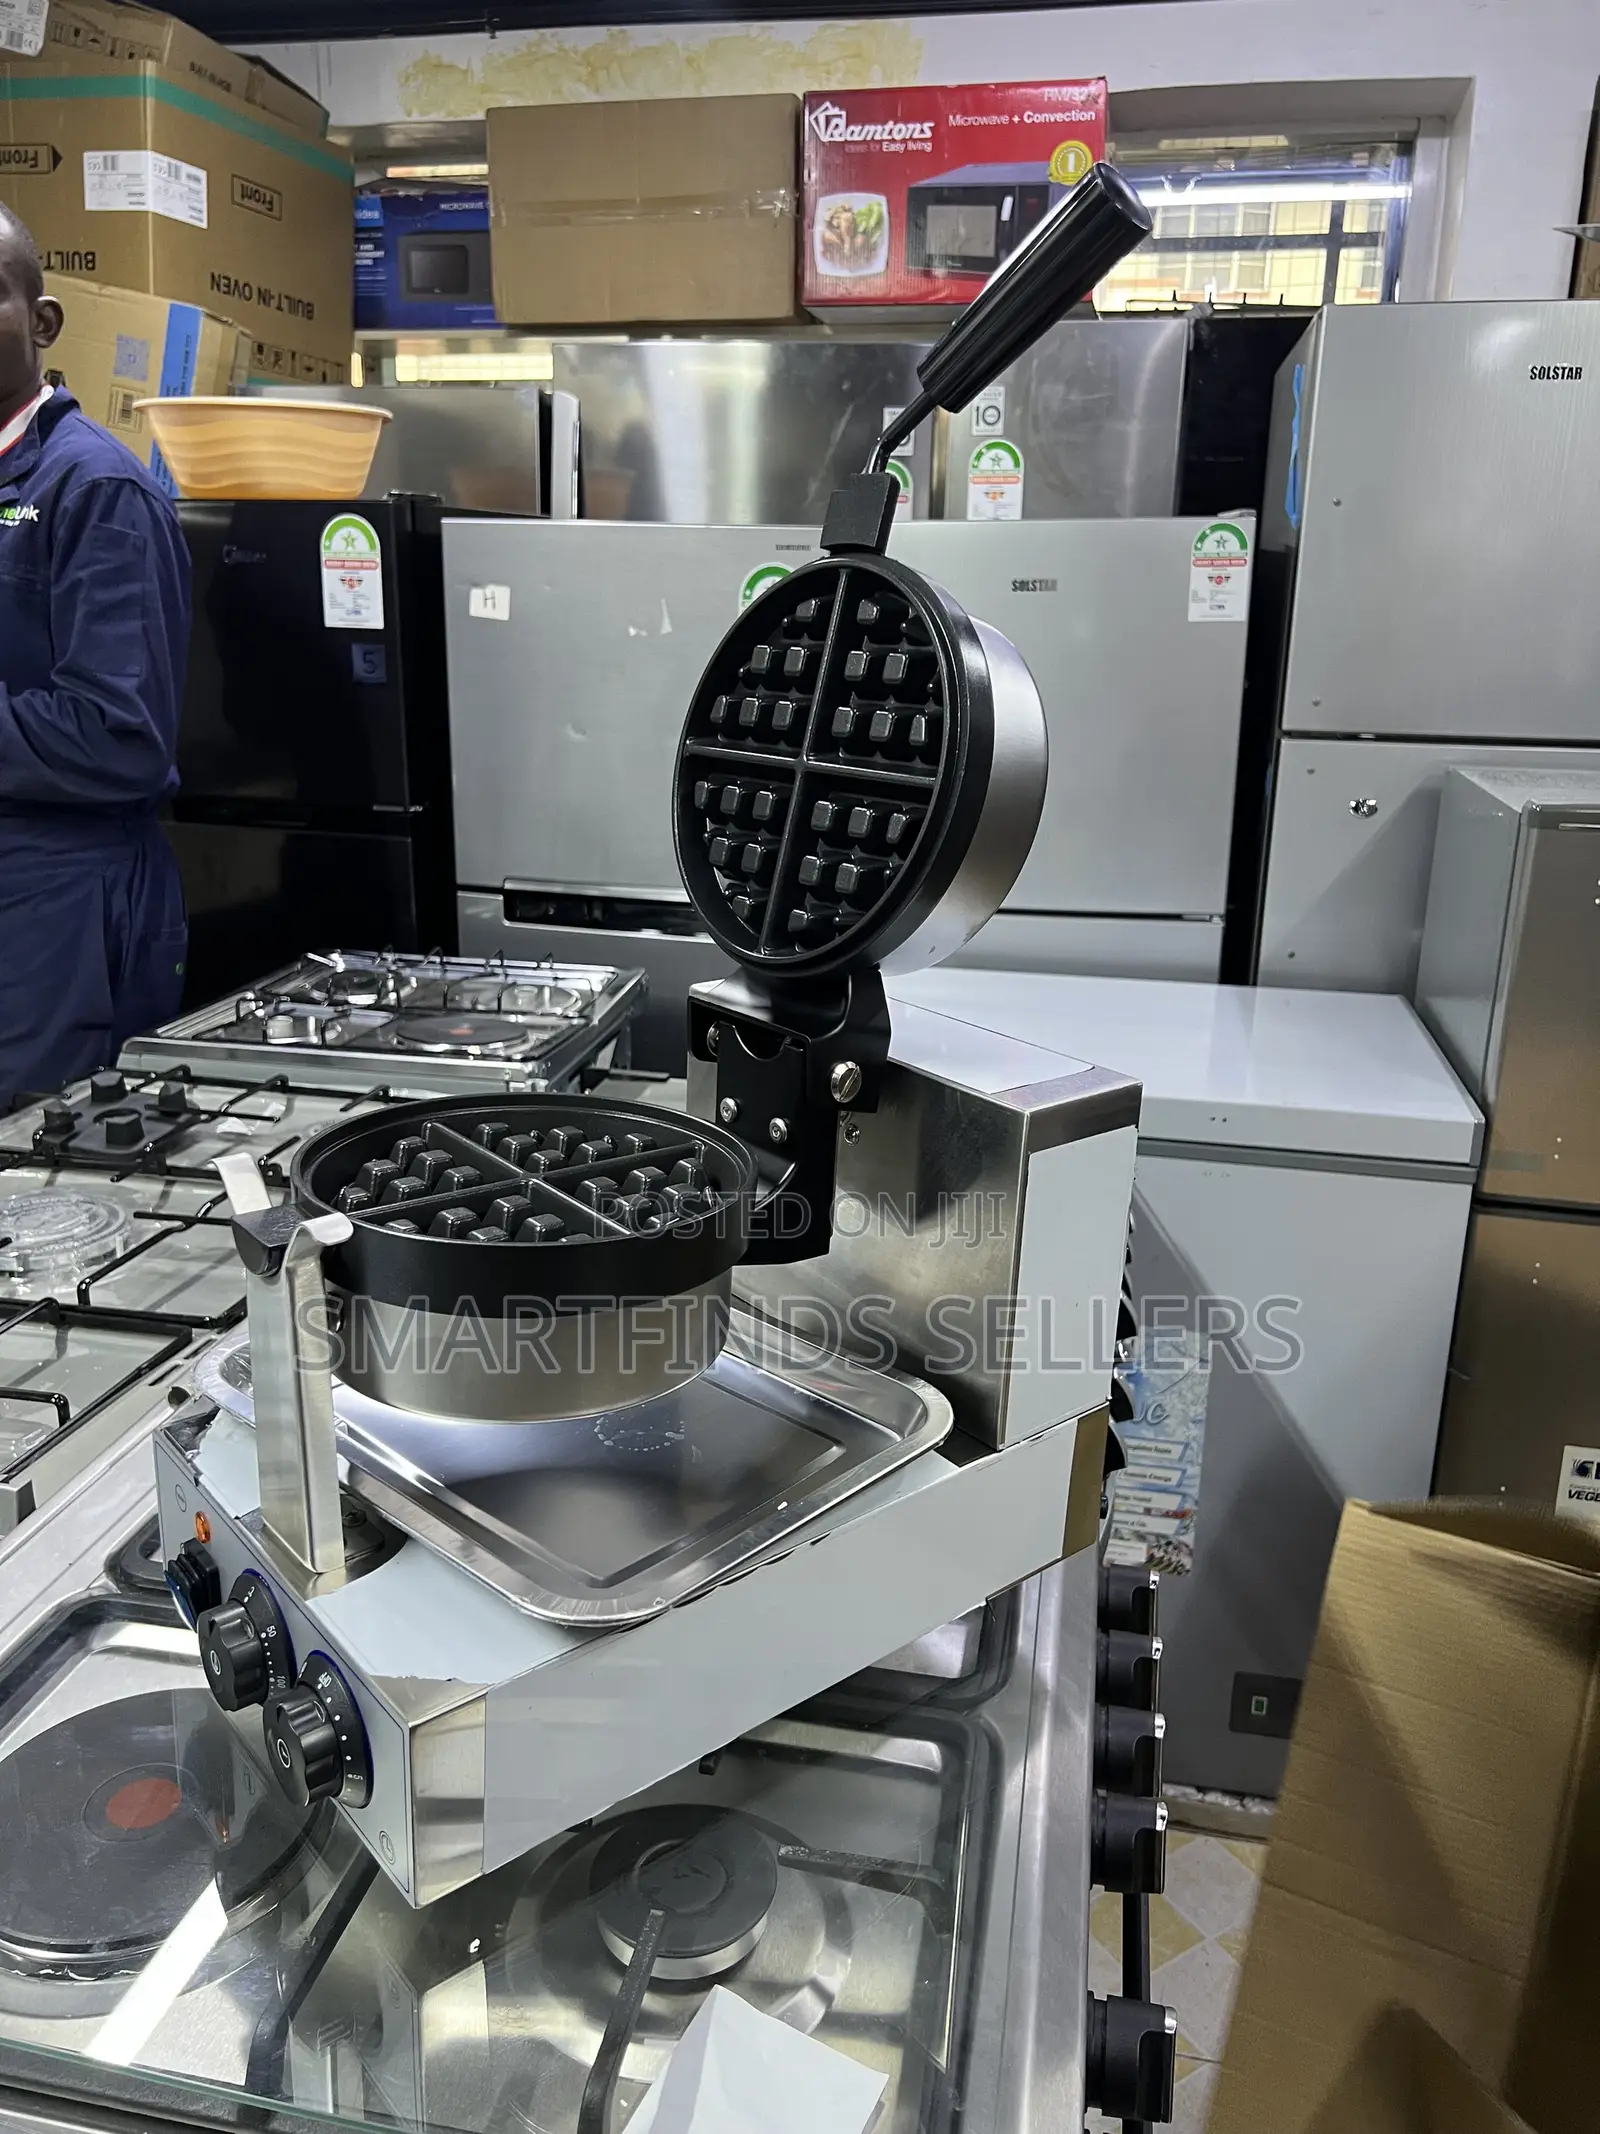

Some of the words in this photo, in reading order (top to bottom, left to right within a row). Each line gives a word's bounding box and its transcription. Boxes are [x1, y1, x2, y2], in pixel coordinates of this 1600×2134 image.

[949, 113, 1010, 127] Microwave
[1023, 109, 1096, 124] Convection
[882, 141, 906, 153] Easy
[907, 140, 933, 153] living
[240, 183, 274, 213] Front
[210, 271, 253, 302] OVEN
[1530, 365, 1583, 380] SOLSTAR
[483, 589, 496, 611] H
[362, 651, 377, 675] 5
[266, 1625, 277, 1637] 50
[276, 1675, 286, 1689] 100
